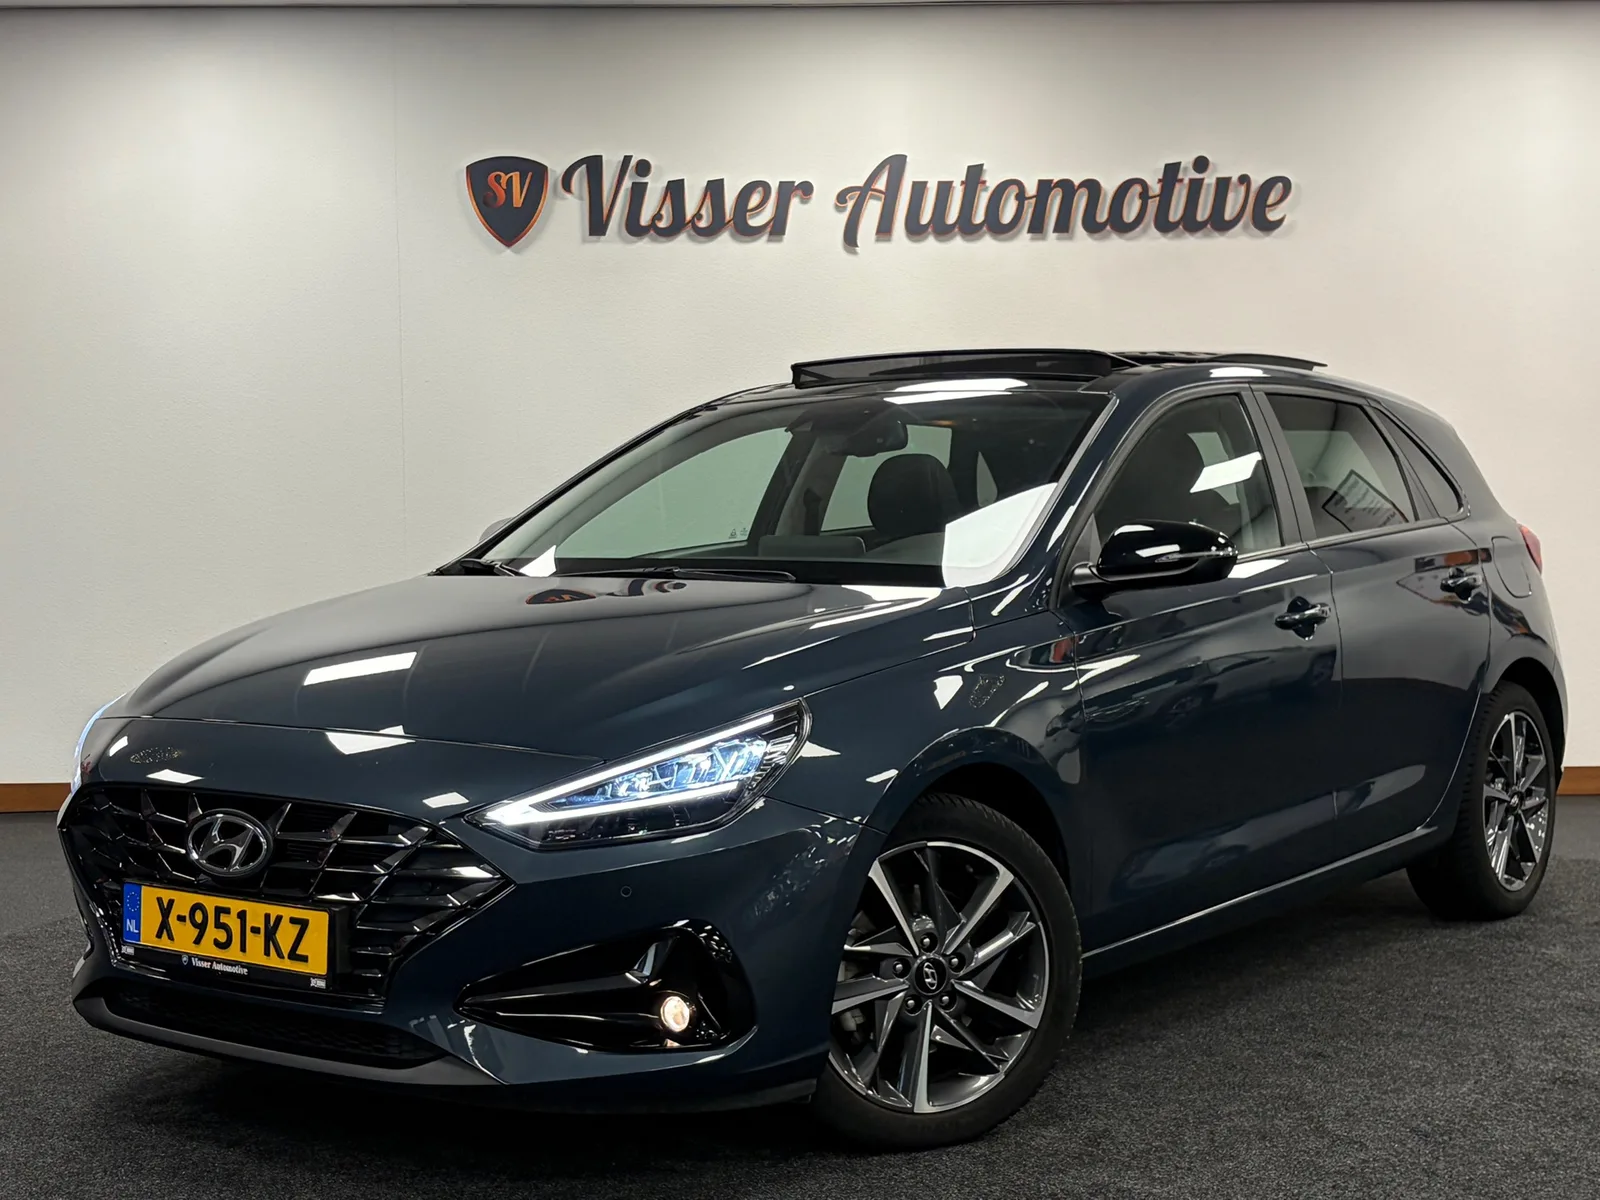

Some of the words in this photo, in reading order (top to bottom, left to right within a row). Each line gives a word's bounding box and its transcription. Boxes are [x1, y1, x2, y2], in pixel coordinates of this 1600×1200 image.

[483, 171, 533, 208] SV
[561, 154, 814, 237] Visser
[835, 154, 1292, 248] Automotive
[126, 918, 140, 933] NL
[155, 896, 310, 964] X-951-KZ
[191, 957, 212, 969] Visser
[211, 961, 249, 975] Automotive
